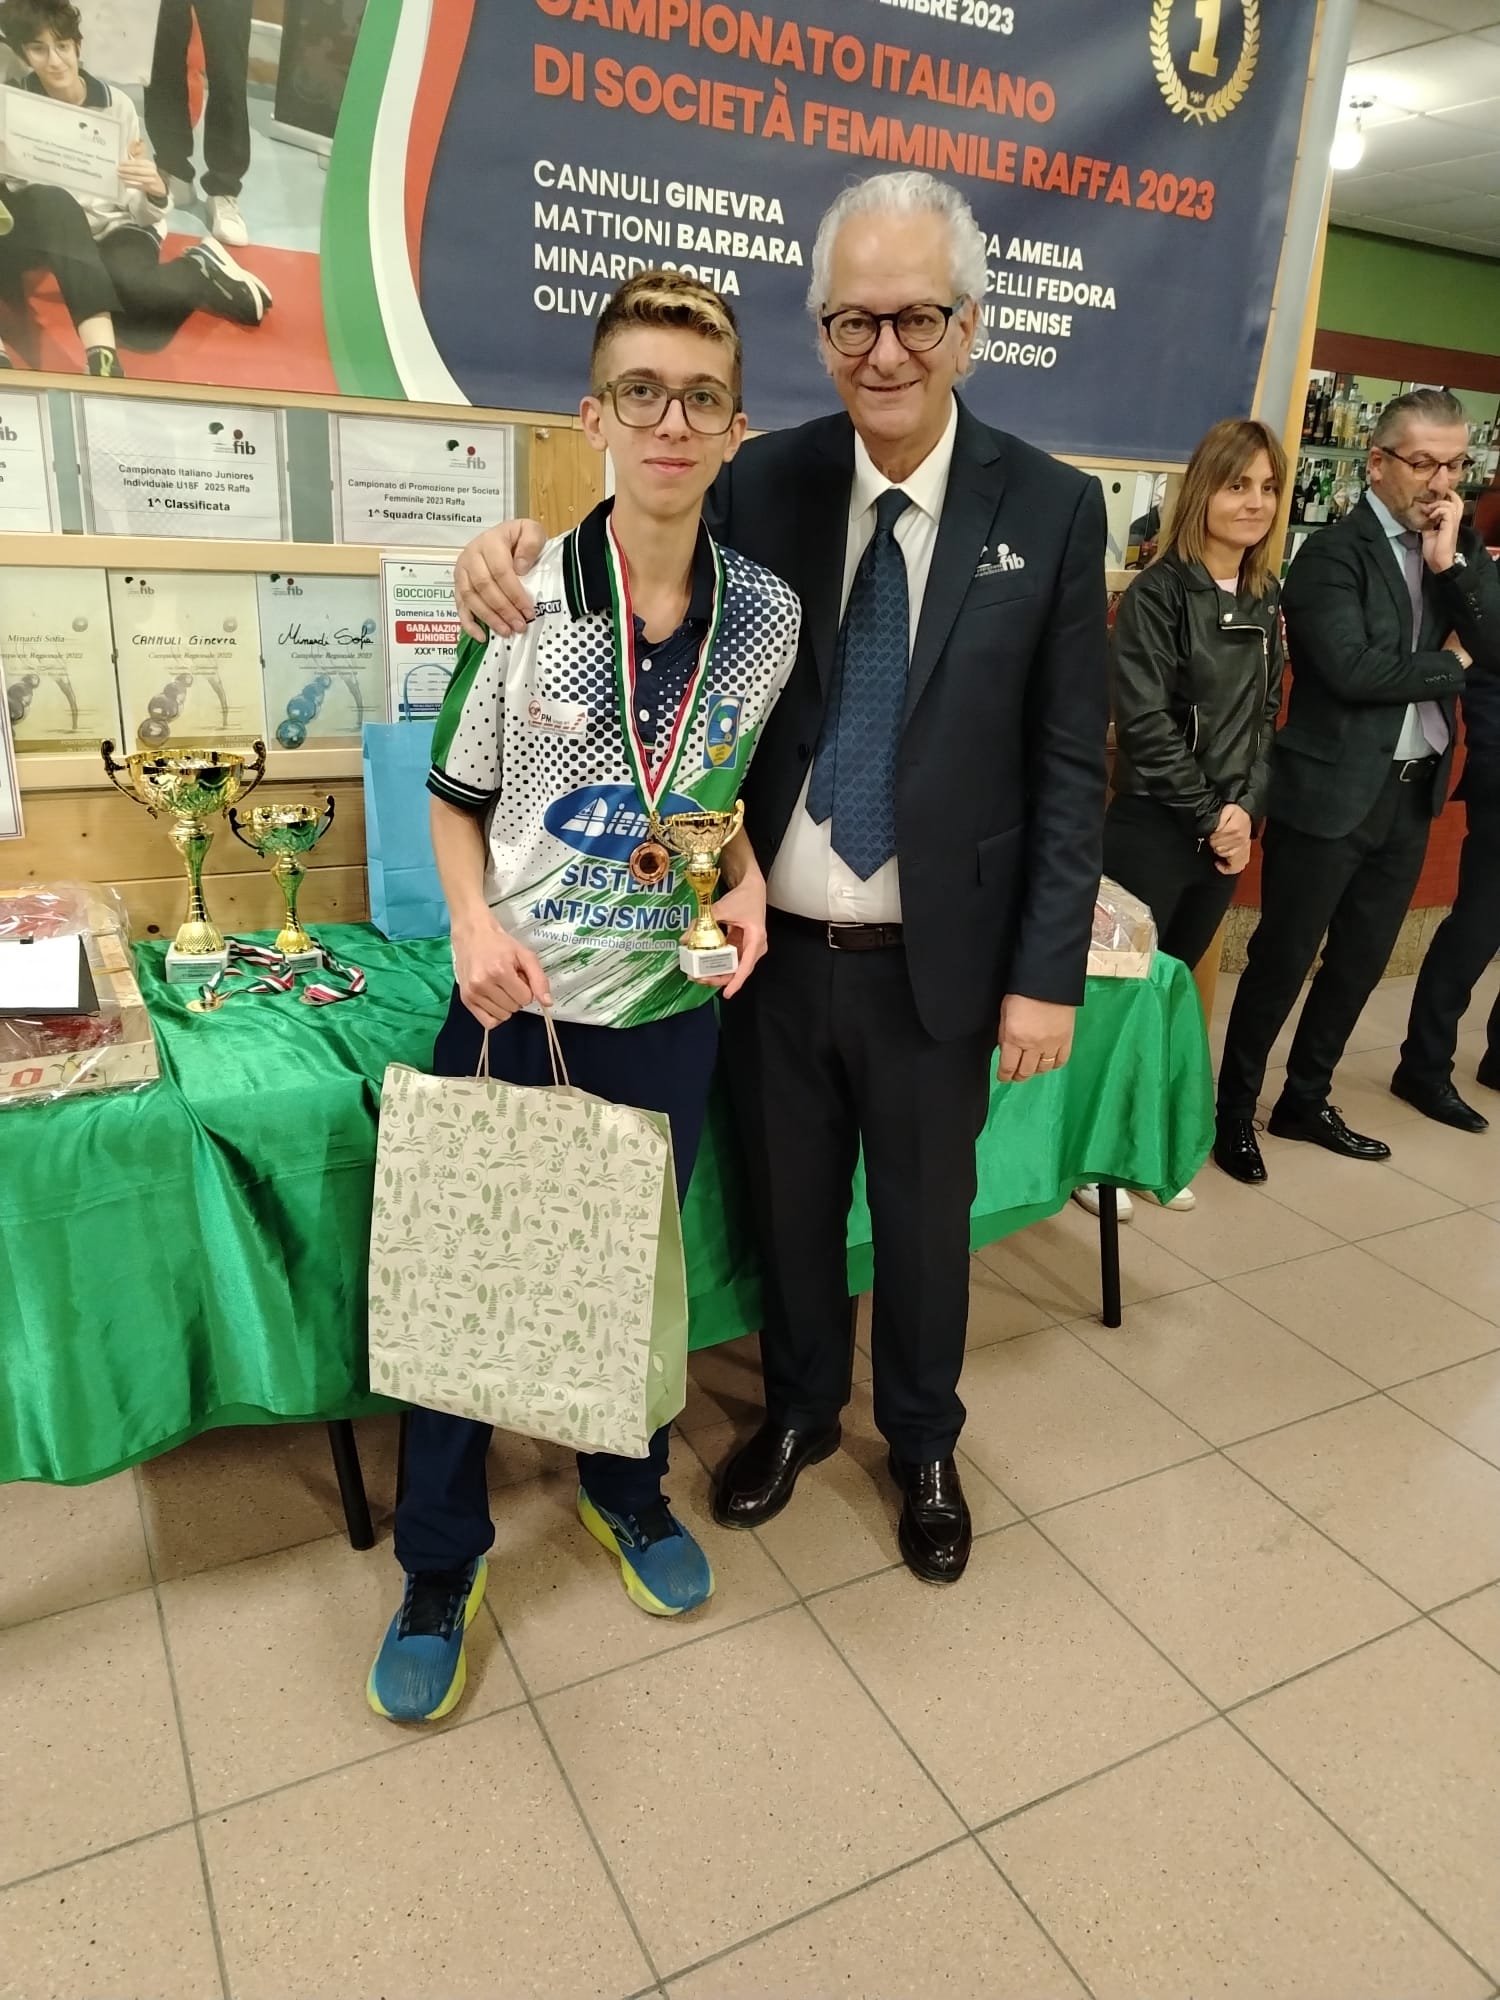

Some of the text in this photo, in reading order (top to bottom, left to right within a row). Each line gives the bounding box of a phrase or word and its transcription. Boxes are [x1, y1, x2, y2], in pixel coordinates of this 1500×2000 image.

[877, 0, 1015, 35] BRE 2023
[871, 43, 1056, 122] ITALIANO
[534, 43, 1216, 220] DI SOCIETÀ FEMMINILE RAFFA 2023
[533, 160, 785, 225] CANNULI GINEVRA
[534, 201, 804, 267] MATTIONI BARBARA
[1006, 237, 1084, 271] AMELIA
[1036, 277, 1117, 309] FEDORA
[1000, 306, 1073, 337] DENISE
[233, 441, 256, 455] fib
[466, 456, 487, 470] fib
[118, 464, 254, 481] Campionato Italiano Juniores
[123, 478, 174, 489] Individuale
[204, 483, 226, 492] 2025
[228, 484, 251, 493] Raffa
[348, 478, 500, 496] Campionato di Promozione per Società
[165, 498, 231, 511] Classificata
[384, 494, 466, 506] Femminile 2023 Raffa
[383, 509, 424, 521] Squadra
[426, 512, 483, 524] Classificata
[999, 552, 1026, 571] fib
[396, 588, 455, 599] BOCCIOFILA
[395, 608, 434, 617] Domenica
[406, 623, 430, 633] GARA
[188, 634, 237, 646] Ginevra
[413, 633, 456, 642] JUNIORES
[533, 927, 676, 951] www.biemmebiagiotti.com
